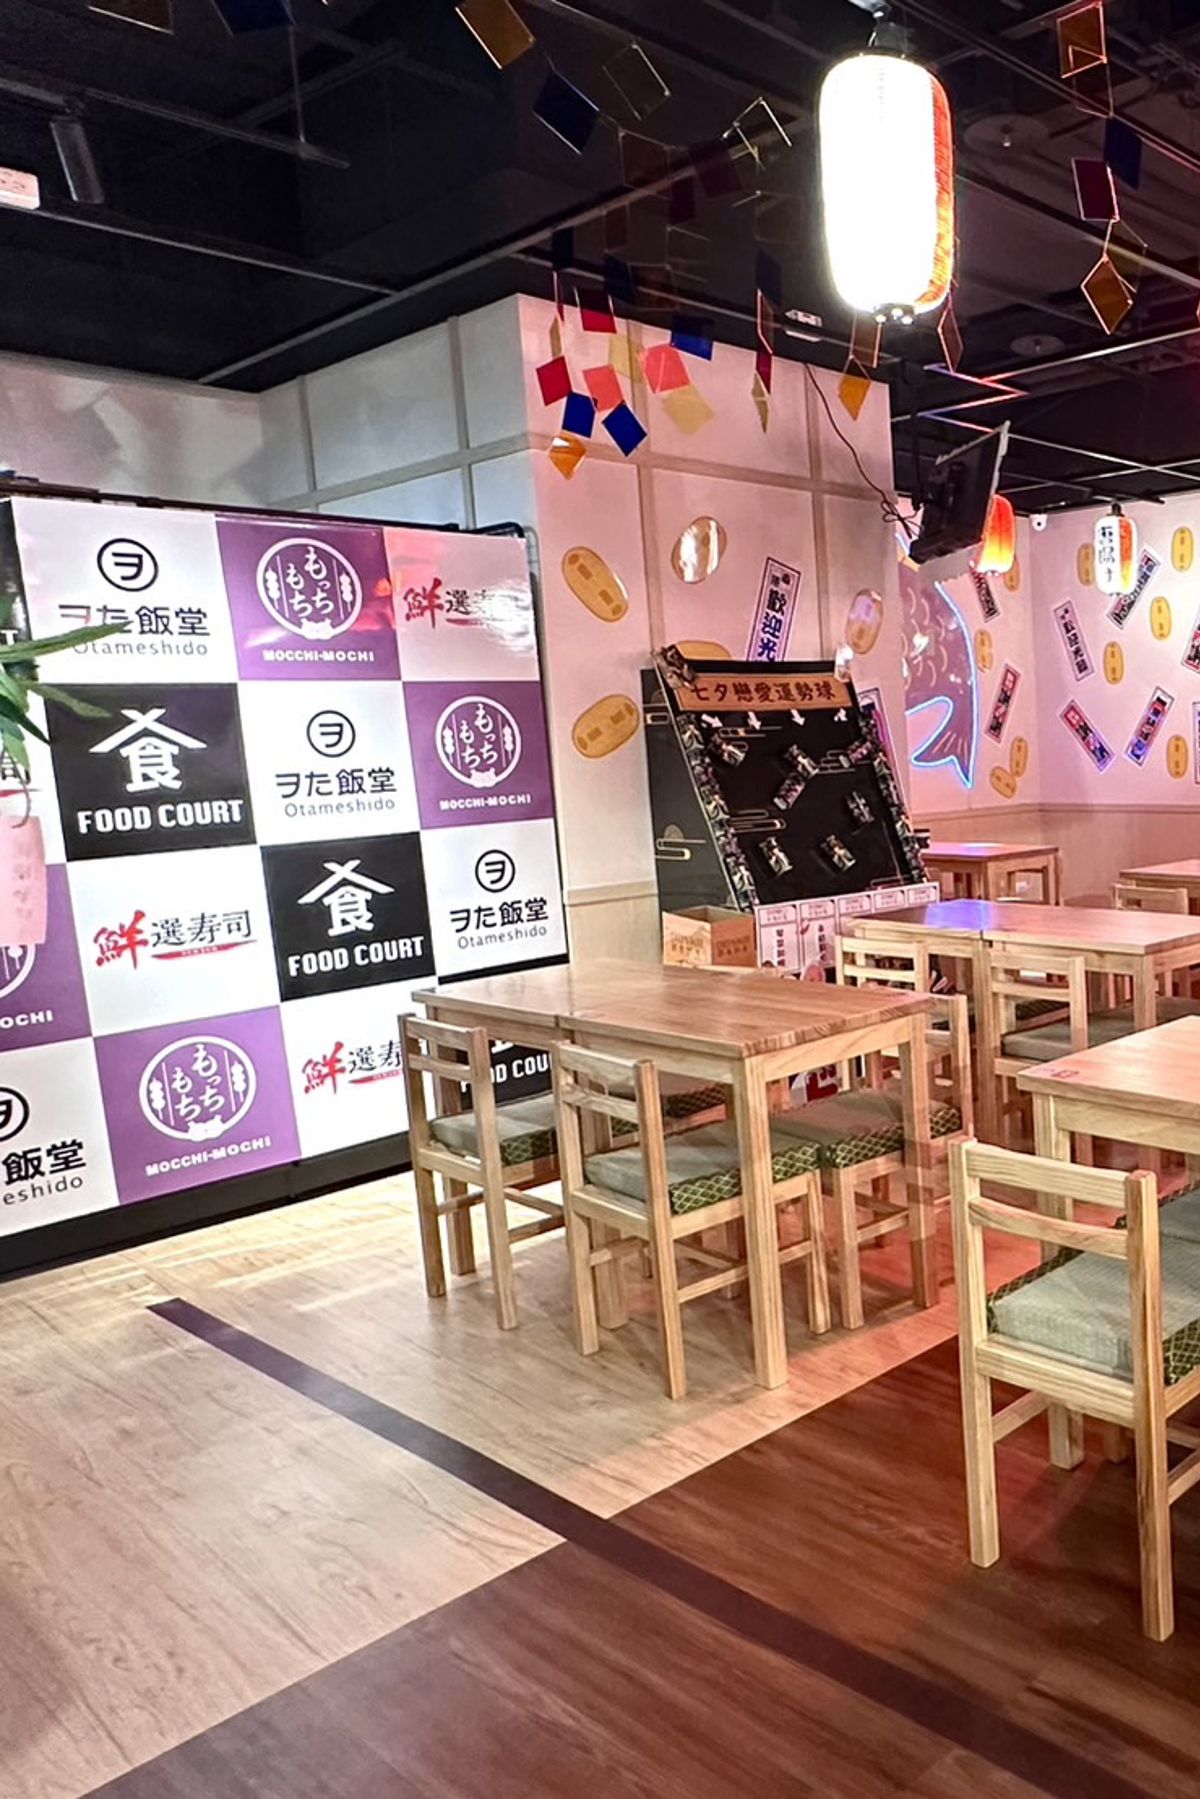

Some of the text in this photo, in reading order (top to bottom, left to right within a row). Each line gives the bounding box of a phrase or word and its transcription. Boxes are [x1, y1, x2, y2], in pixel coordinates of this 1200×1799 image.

[275, 766, 397, 799] ヲた飯堂
[77, 800, 243, 834] FOOD COURT
[285, 798, 395, 818] Otameshido
[450, 897, 549, 933] ヲた飯堂
[458, 926, 548, 949] Otameshido
[288, 936, 425, 977] FOOD COURT
